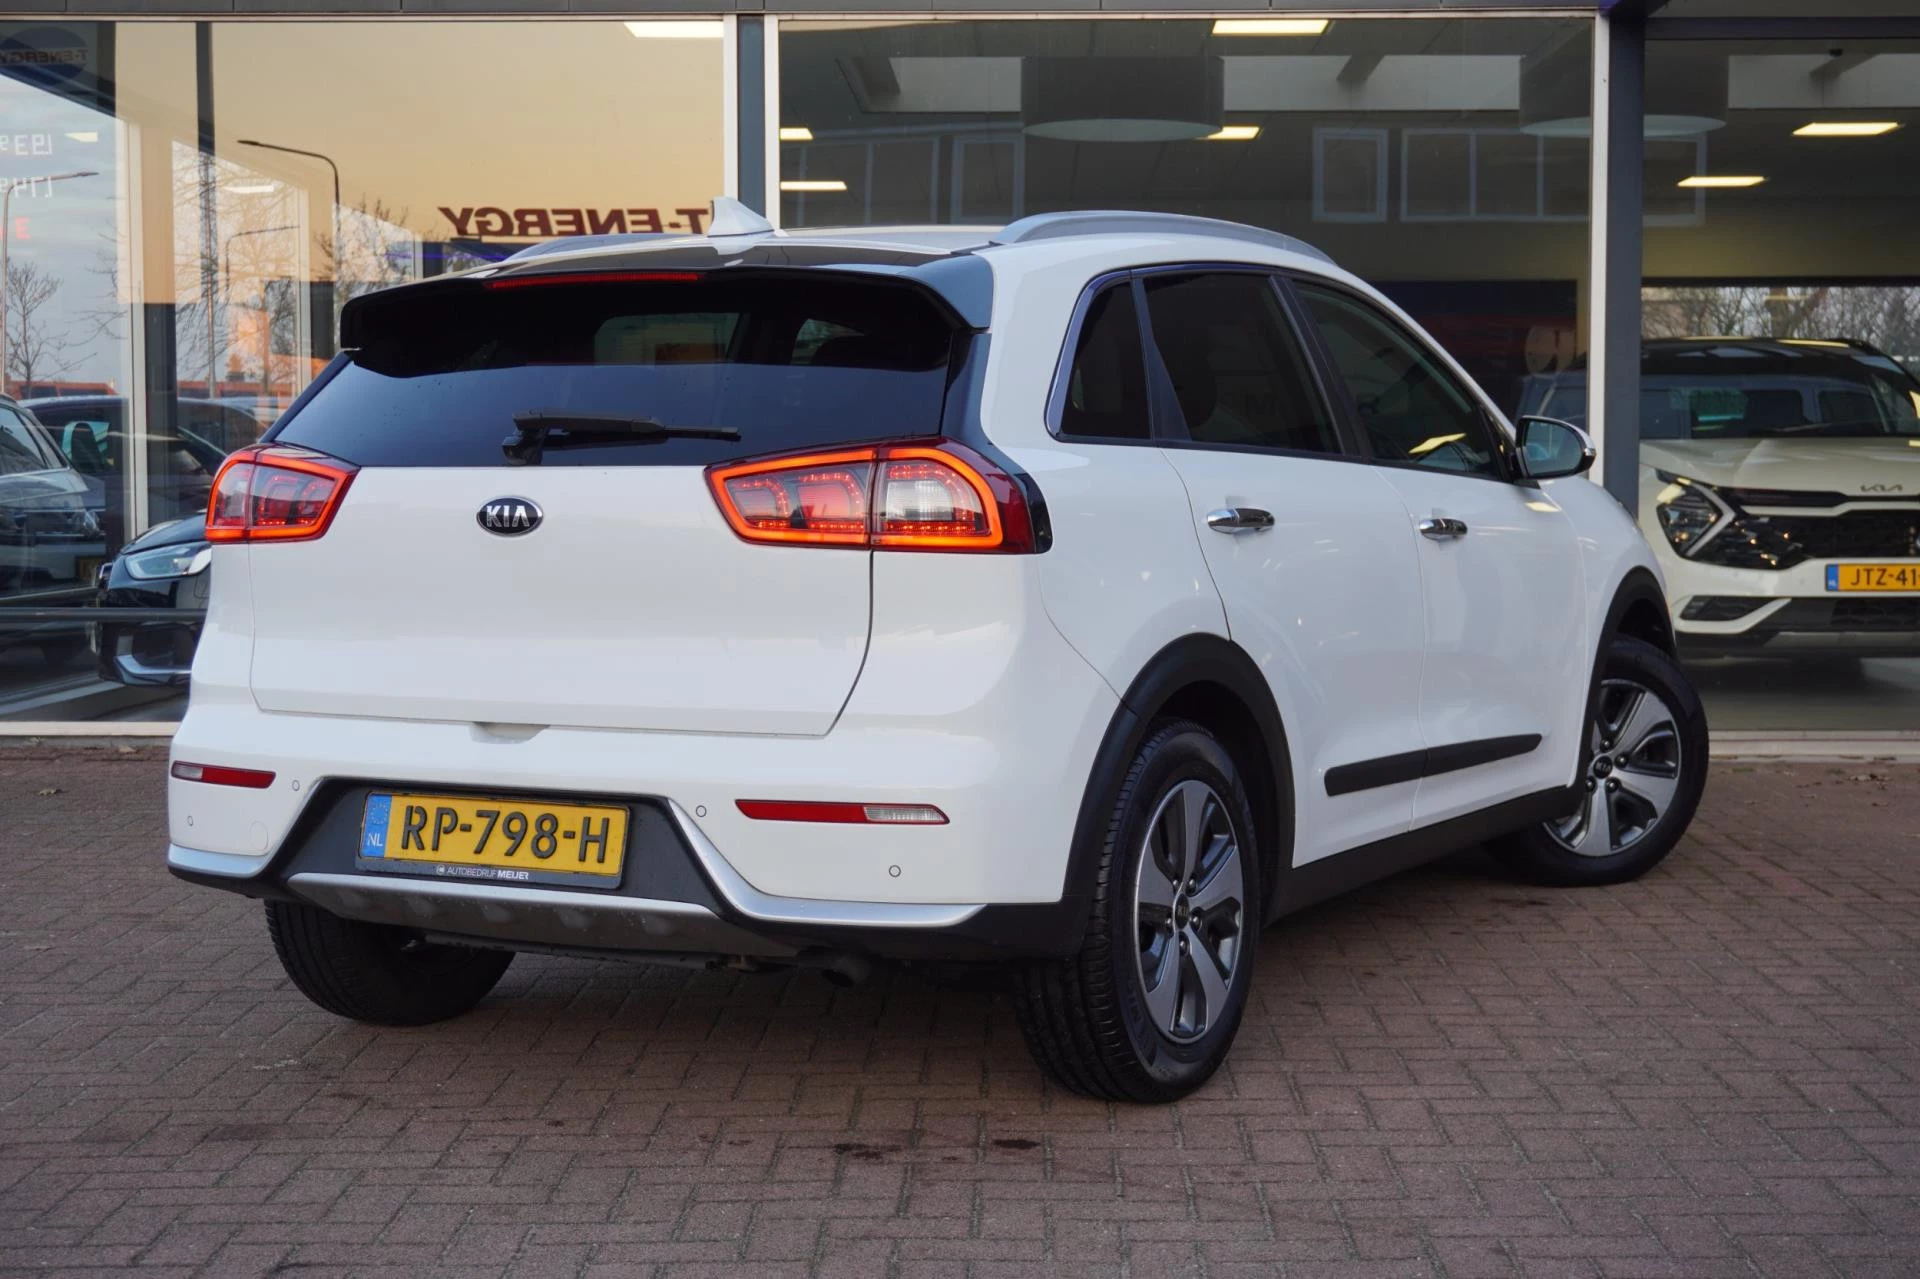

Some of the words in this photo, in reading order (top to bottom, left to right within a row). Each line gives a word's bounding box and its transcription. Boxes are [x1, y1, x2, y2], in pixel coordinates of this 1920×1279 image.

[486, 505, 530, 527] KIA
[367, 832, 383, 847] NL
[401, 805, 610, 863] RP-798-H
[447, 866, 497, 878] AUTOBEDRIJF
